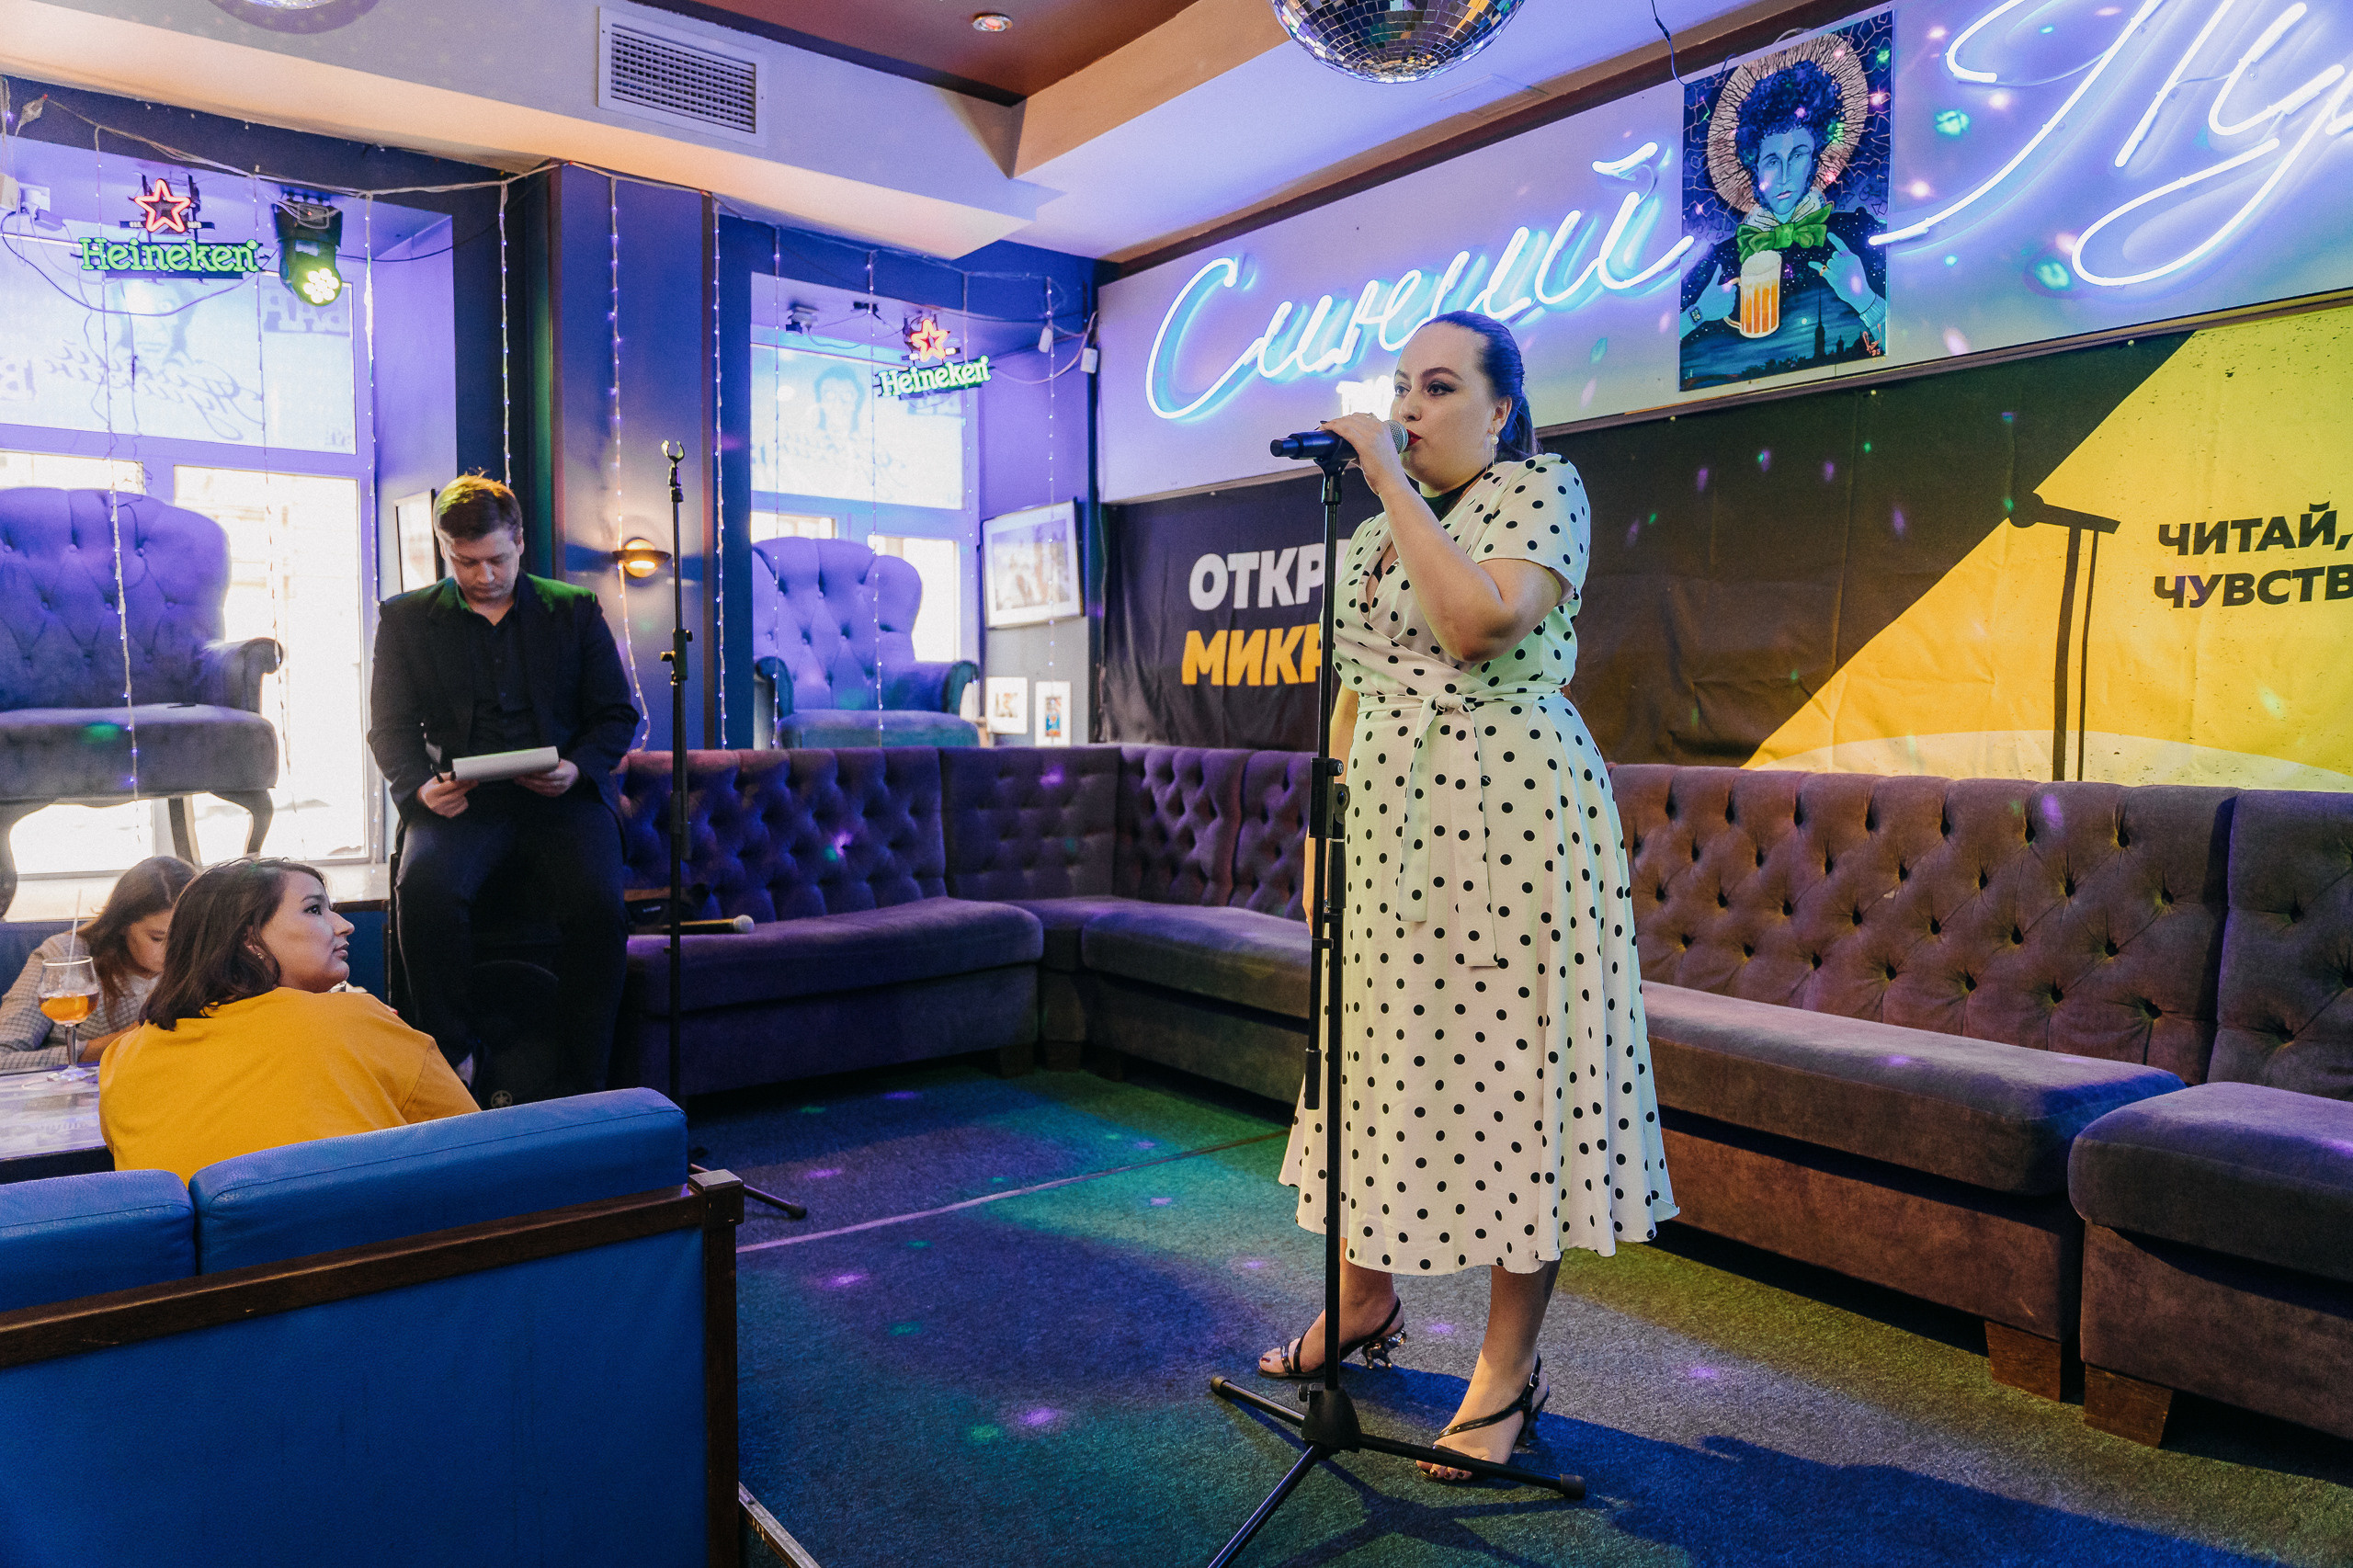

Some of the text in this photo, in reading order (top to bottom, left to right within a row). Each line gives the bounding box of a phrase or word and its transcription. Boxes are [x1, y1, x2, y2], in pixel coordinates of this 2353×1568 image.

[1145, 0, 2353, 418] Синий Пу
[79, 237, 259, 272] Heineken
[878, 355, 992, 396] Heineken
[2158, 501, 2353, 555] ЧИТАЙ,
[2154, 563, 2353, 608] ЧУВСТВ
